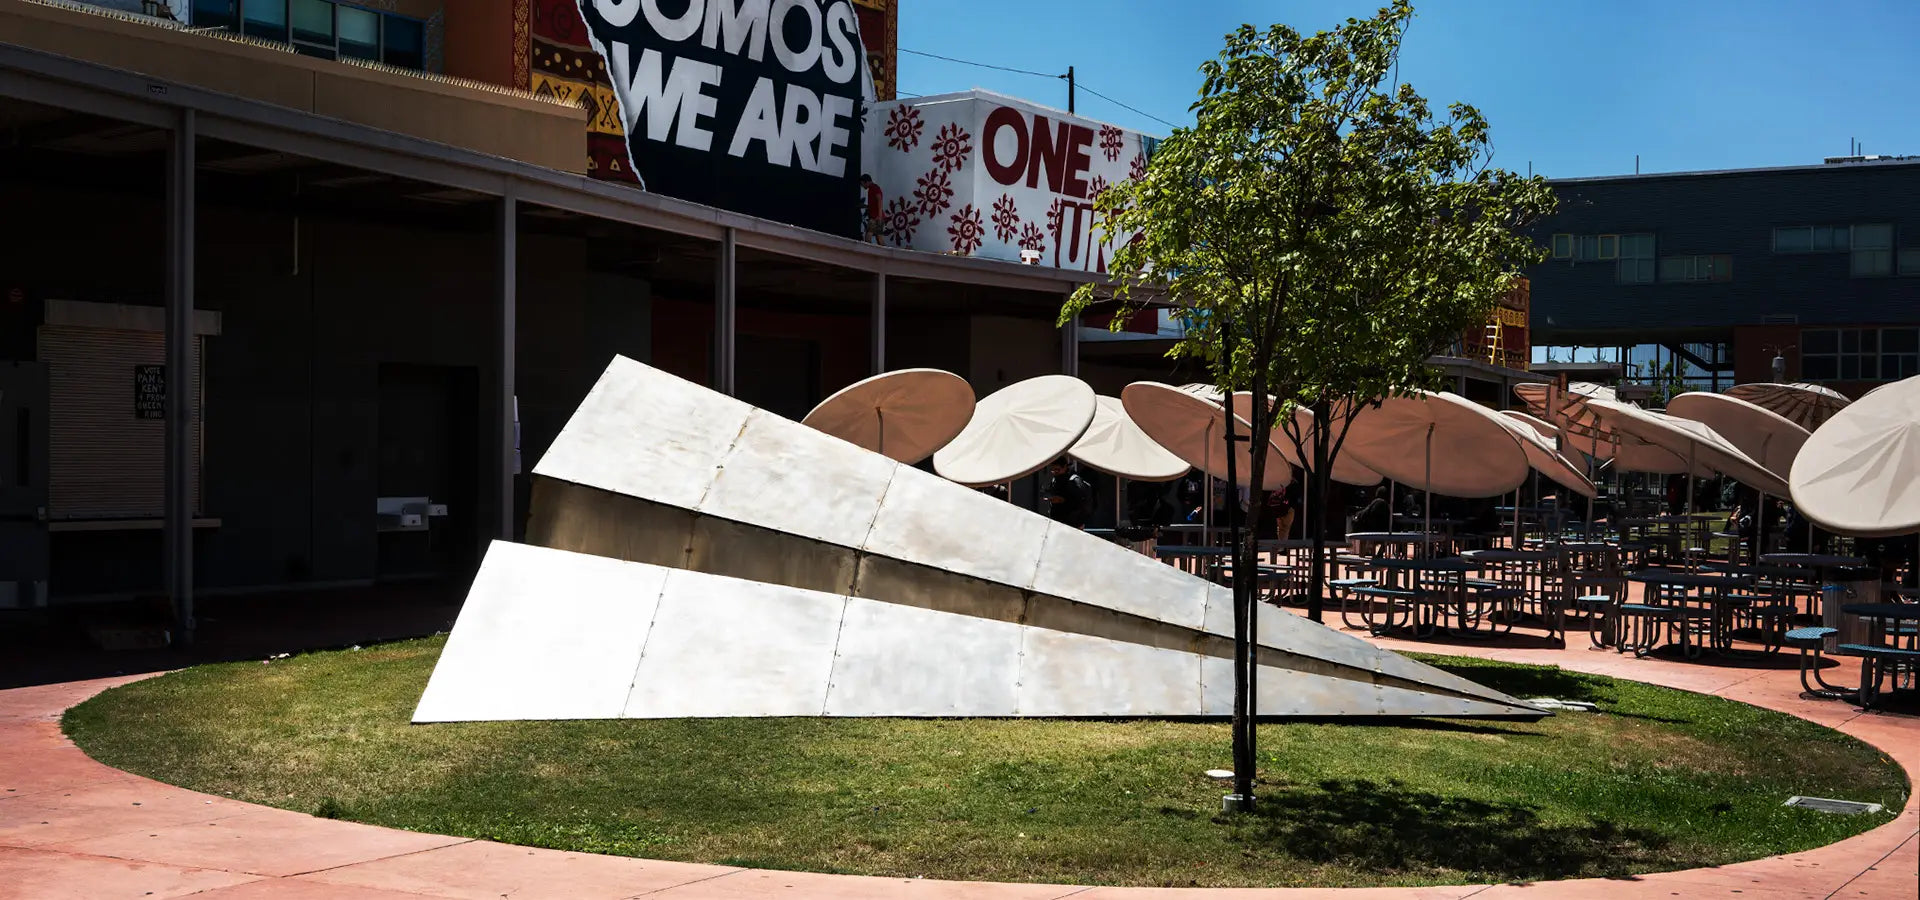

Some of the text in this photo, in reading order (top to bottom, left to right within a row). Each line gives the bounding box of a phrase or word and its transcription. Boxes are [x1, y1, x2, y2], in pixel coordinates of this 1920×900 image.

[596, 0, 857, 84] MOS
[611, 40, 854, 178] WE ARE
[982, 106, 1094, 199] ONE
